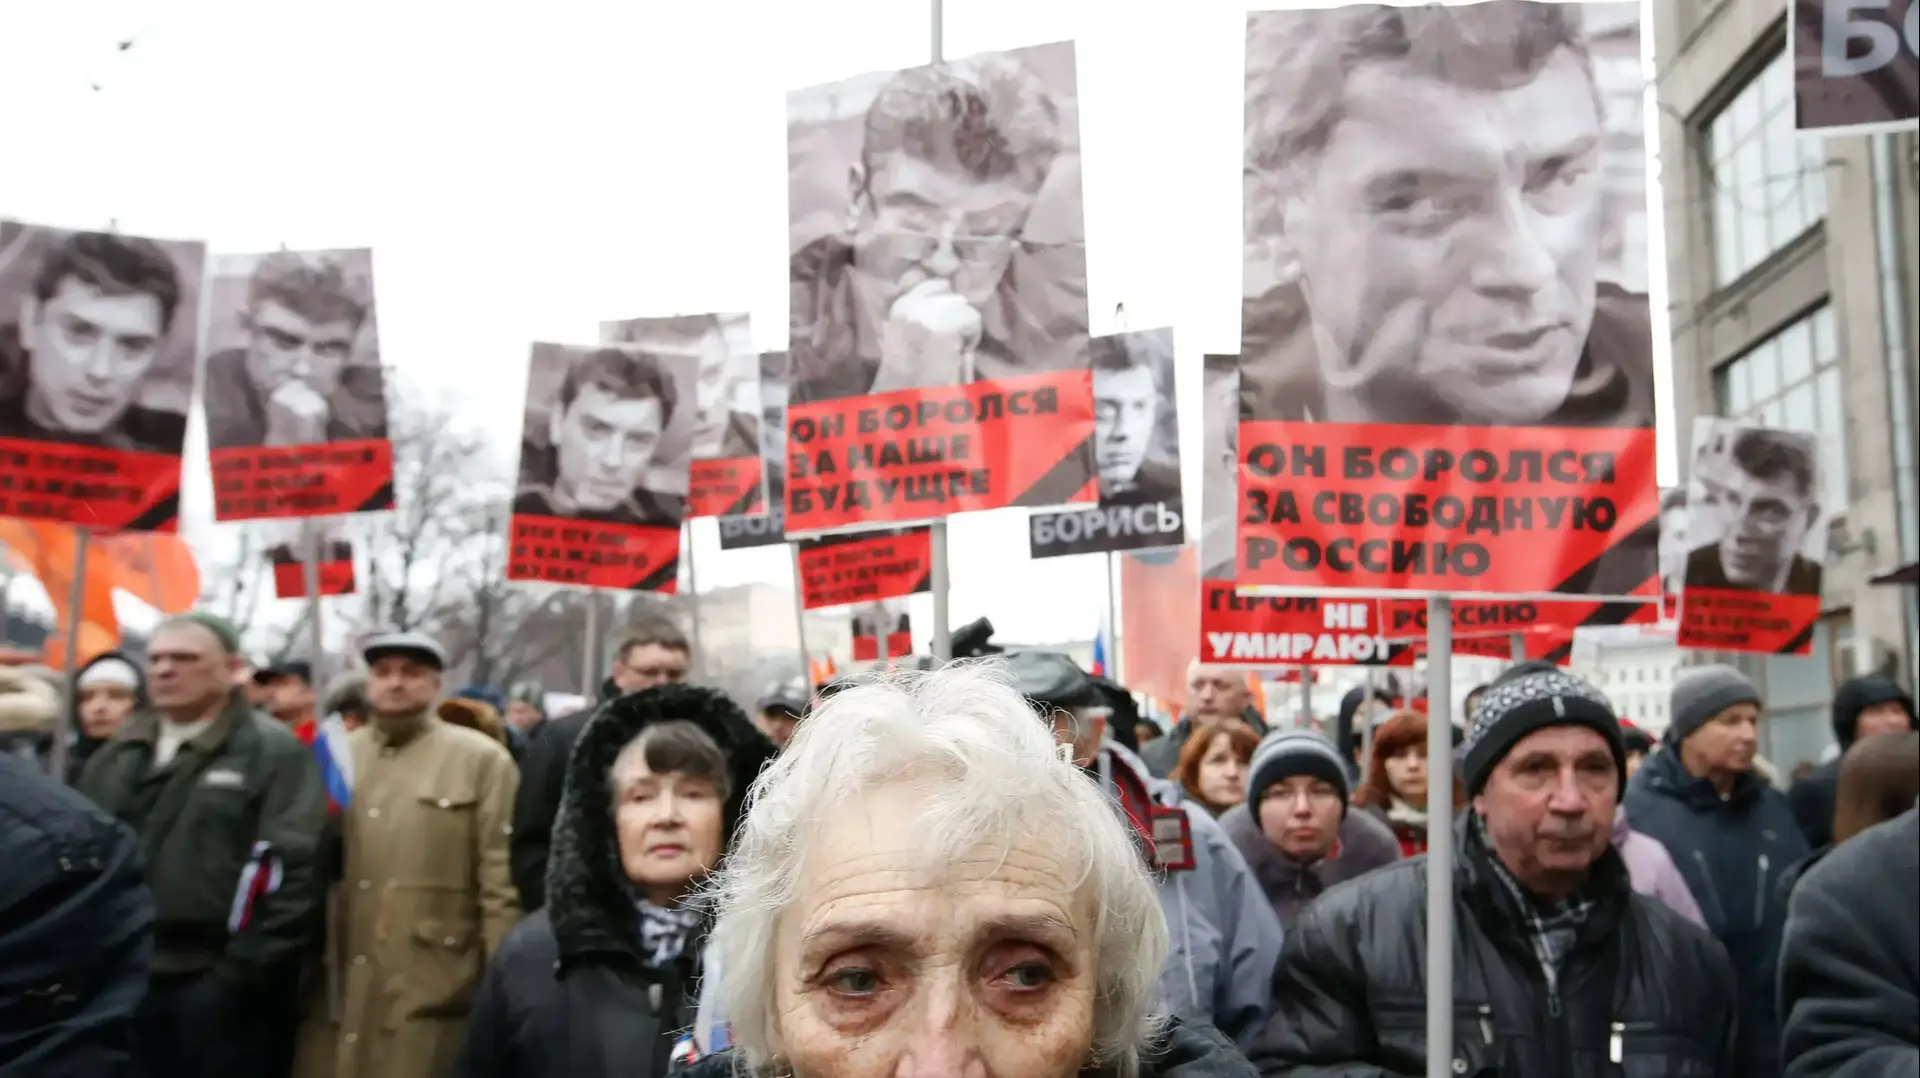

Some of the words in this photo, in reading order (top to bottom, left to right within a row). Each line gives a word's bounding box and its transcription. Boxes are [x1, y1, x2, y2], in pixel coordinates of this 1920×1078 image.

[1822, 0, 1919, 76] Б
[791, 413, 844, 444] ОН
[858, 387, 1058, 434] БОРОЛСЯ
[791, 452, 835, 478] ЗА
[848, 434, 970, 471] НАШЕ
[1247, 444, 1325, 477] ОН
[1342, 446, 1615, 484] БОРОЛСЯ
[791, 469, 990, 514] БУДУЩЕЕ
[1244, 490, 1300, 524] ЗА
[1312, 493, 1616, 535] СВОБОДНУЮ
[1032, 502, 1180, 543] БОРИСЬ
[1246, 537, 1490, 576] РОССИЮ
[1323, 602, 1367, 629] НЕ
[1207, 632, 1389, 660] УМИРАЮТ
